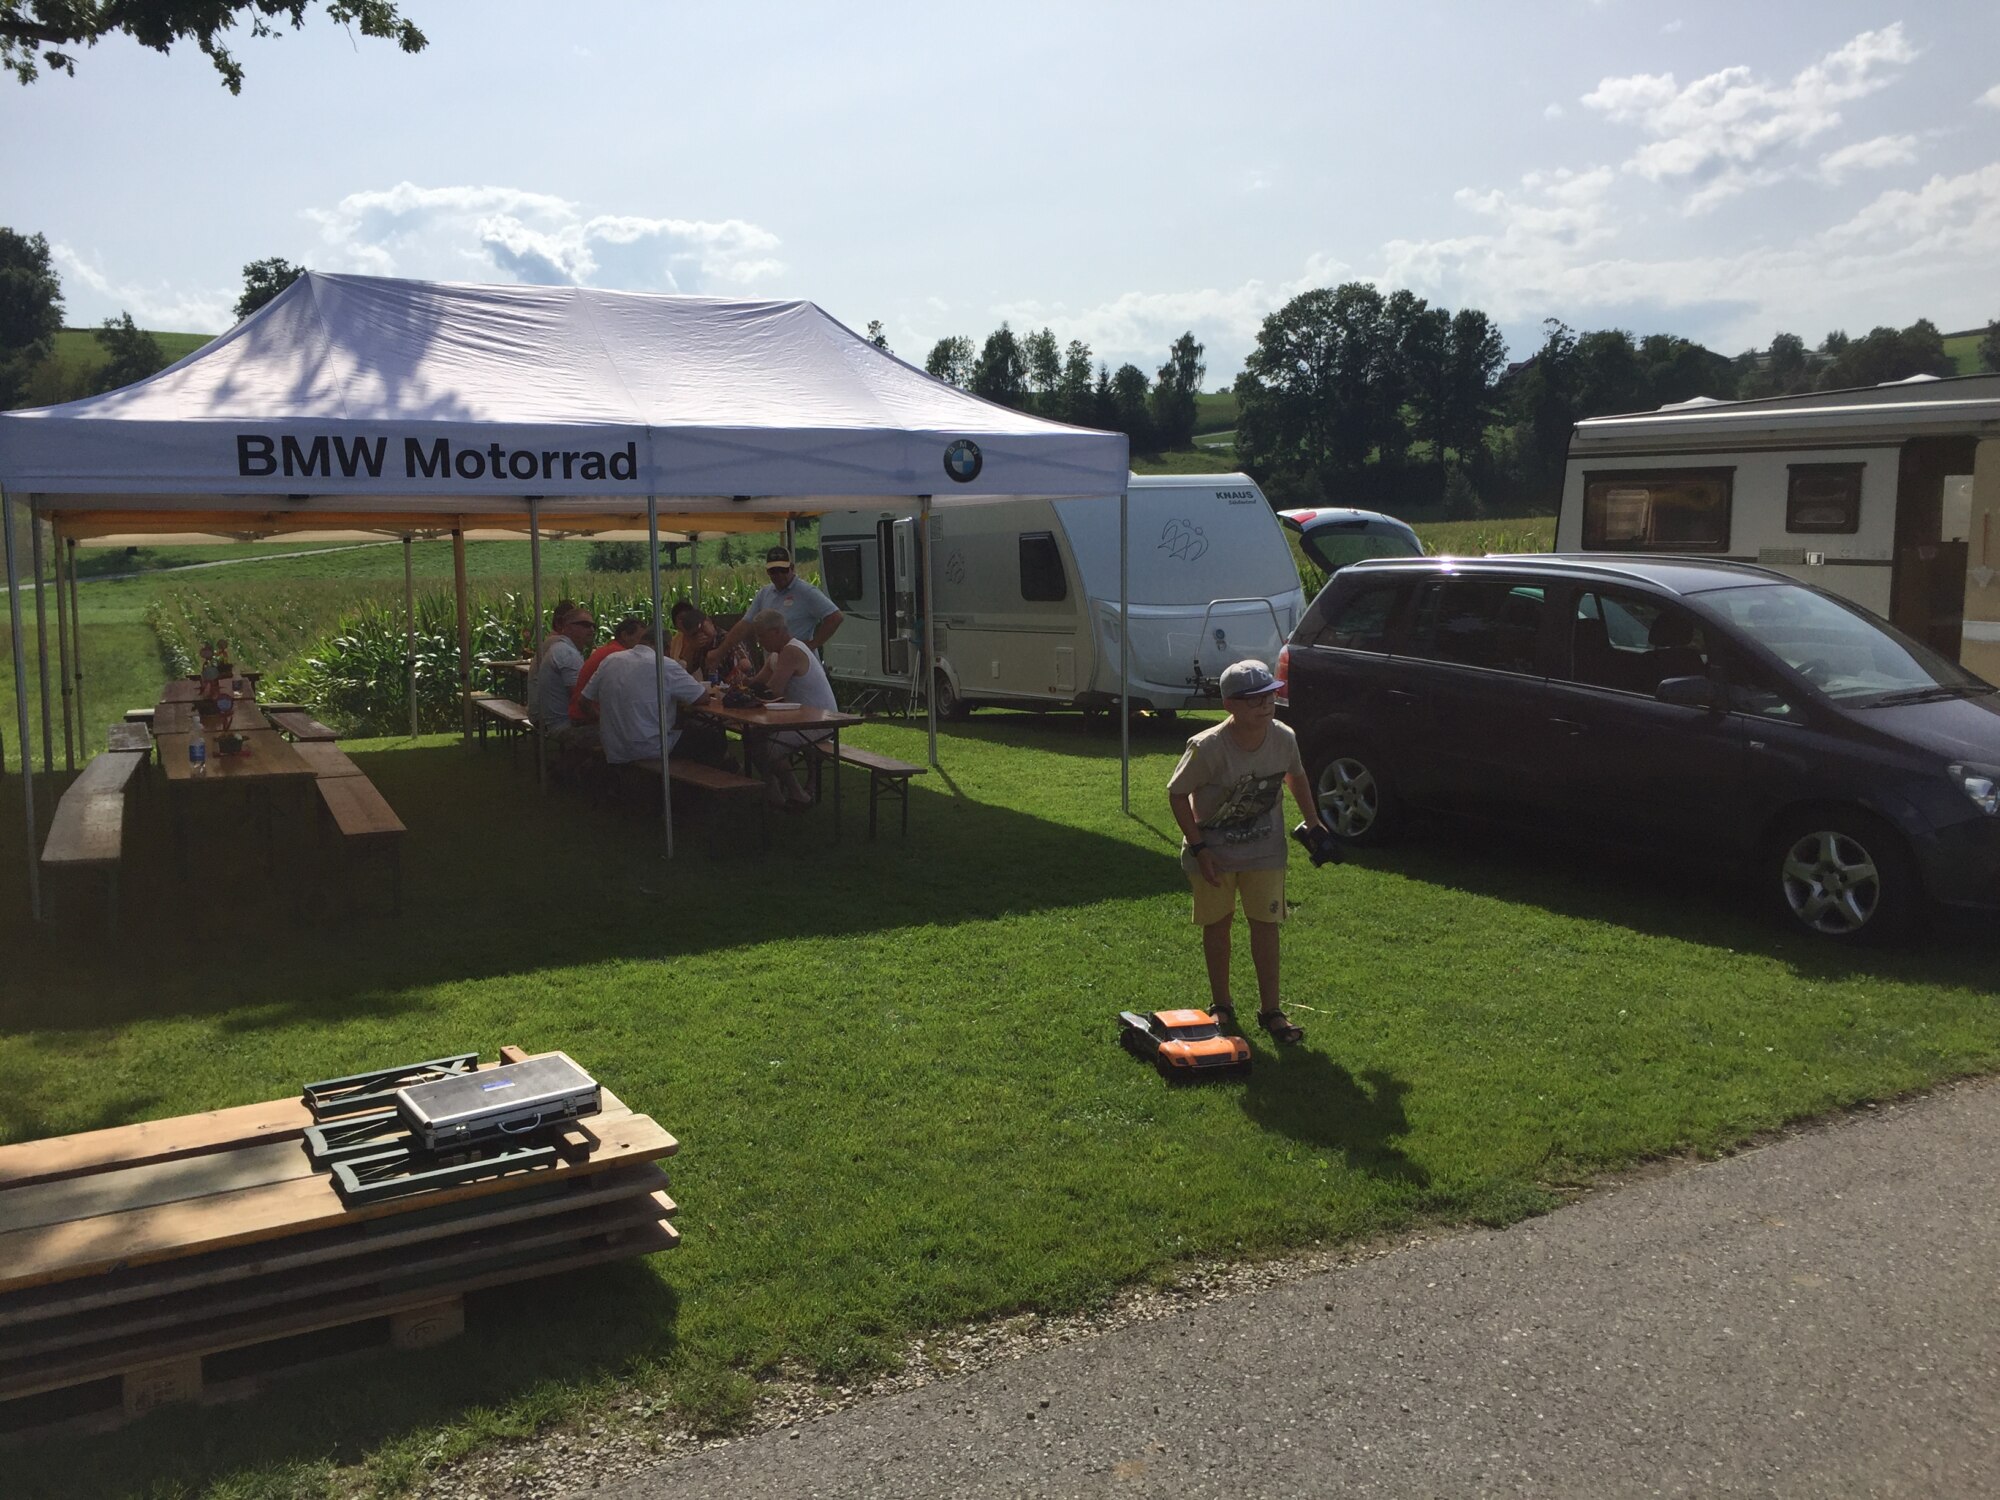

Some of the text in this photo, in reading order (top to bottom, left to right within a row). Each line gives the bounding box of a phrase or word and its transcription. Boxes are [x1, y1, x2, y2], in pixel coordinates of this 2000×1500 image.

[948, 441, 978, 455] BMW
[236, 434, 638, 480] BMW Motorrad
[1215, 491, 1254, 499] KNAUS
